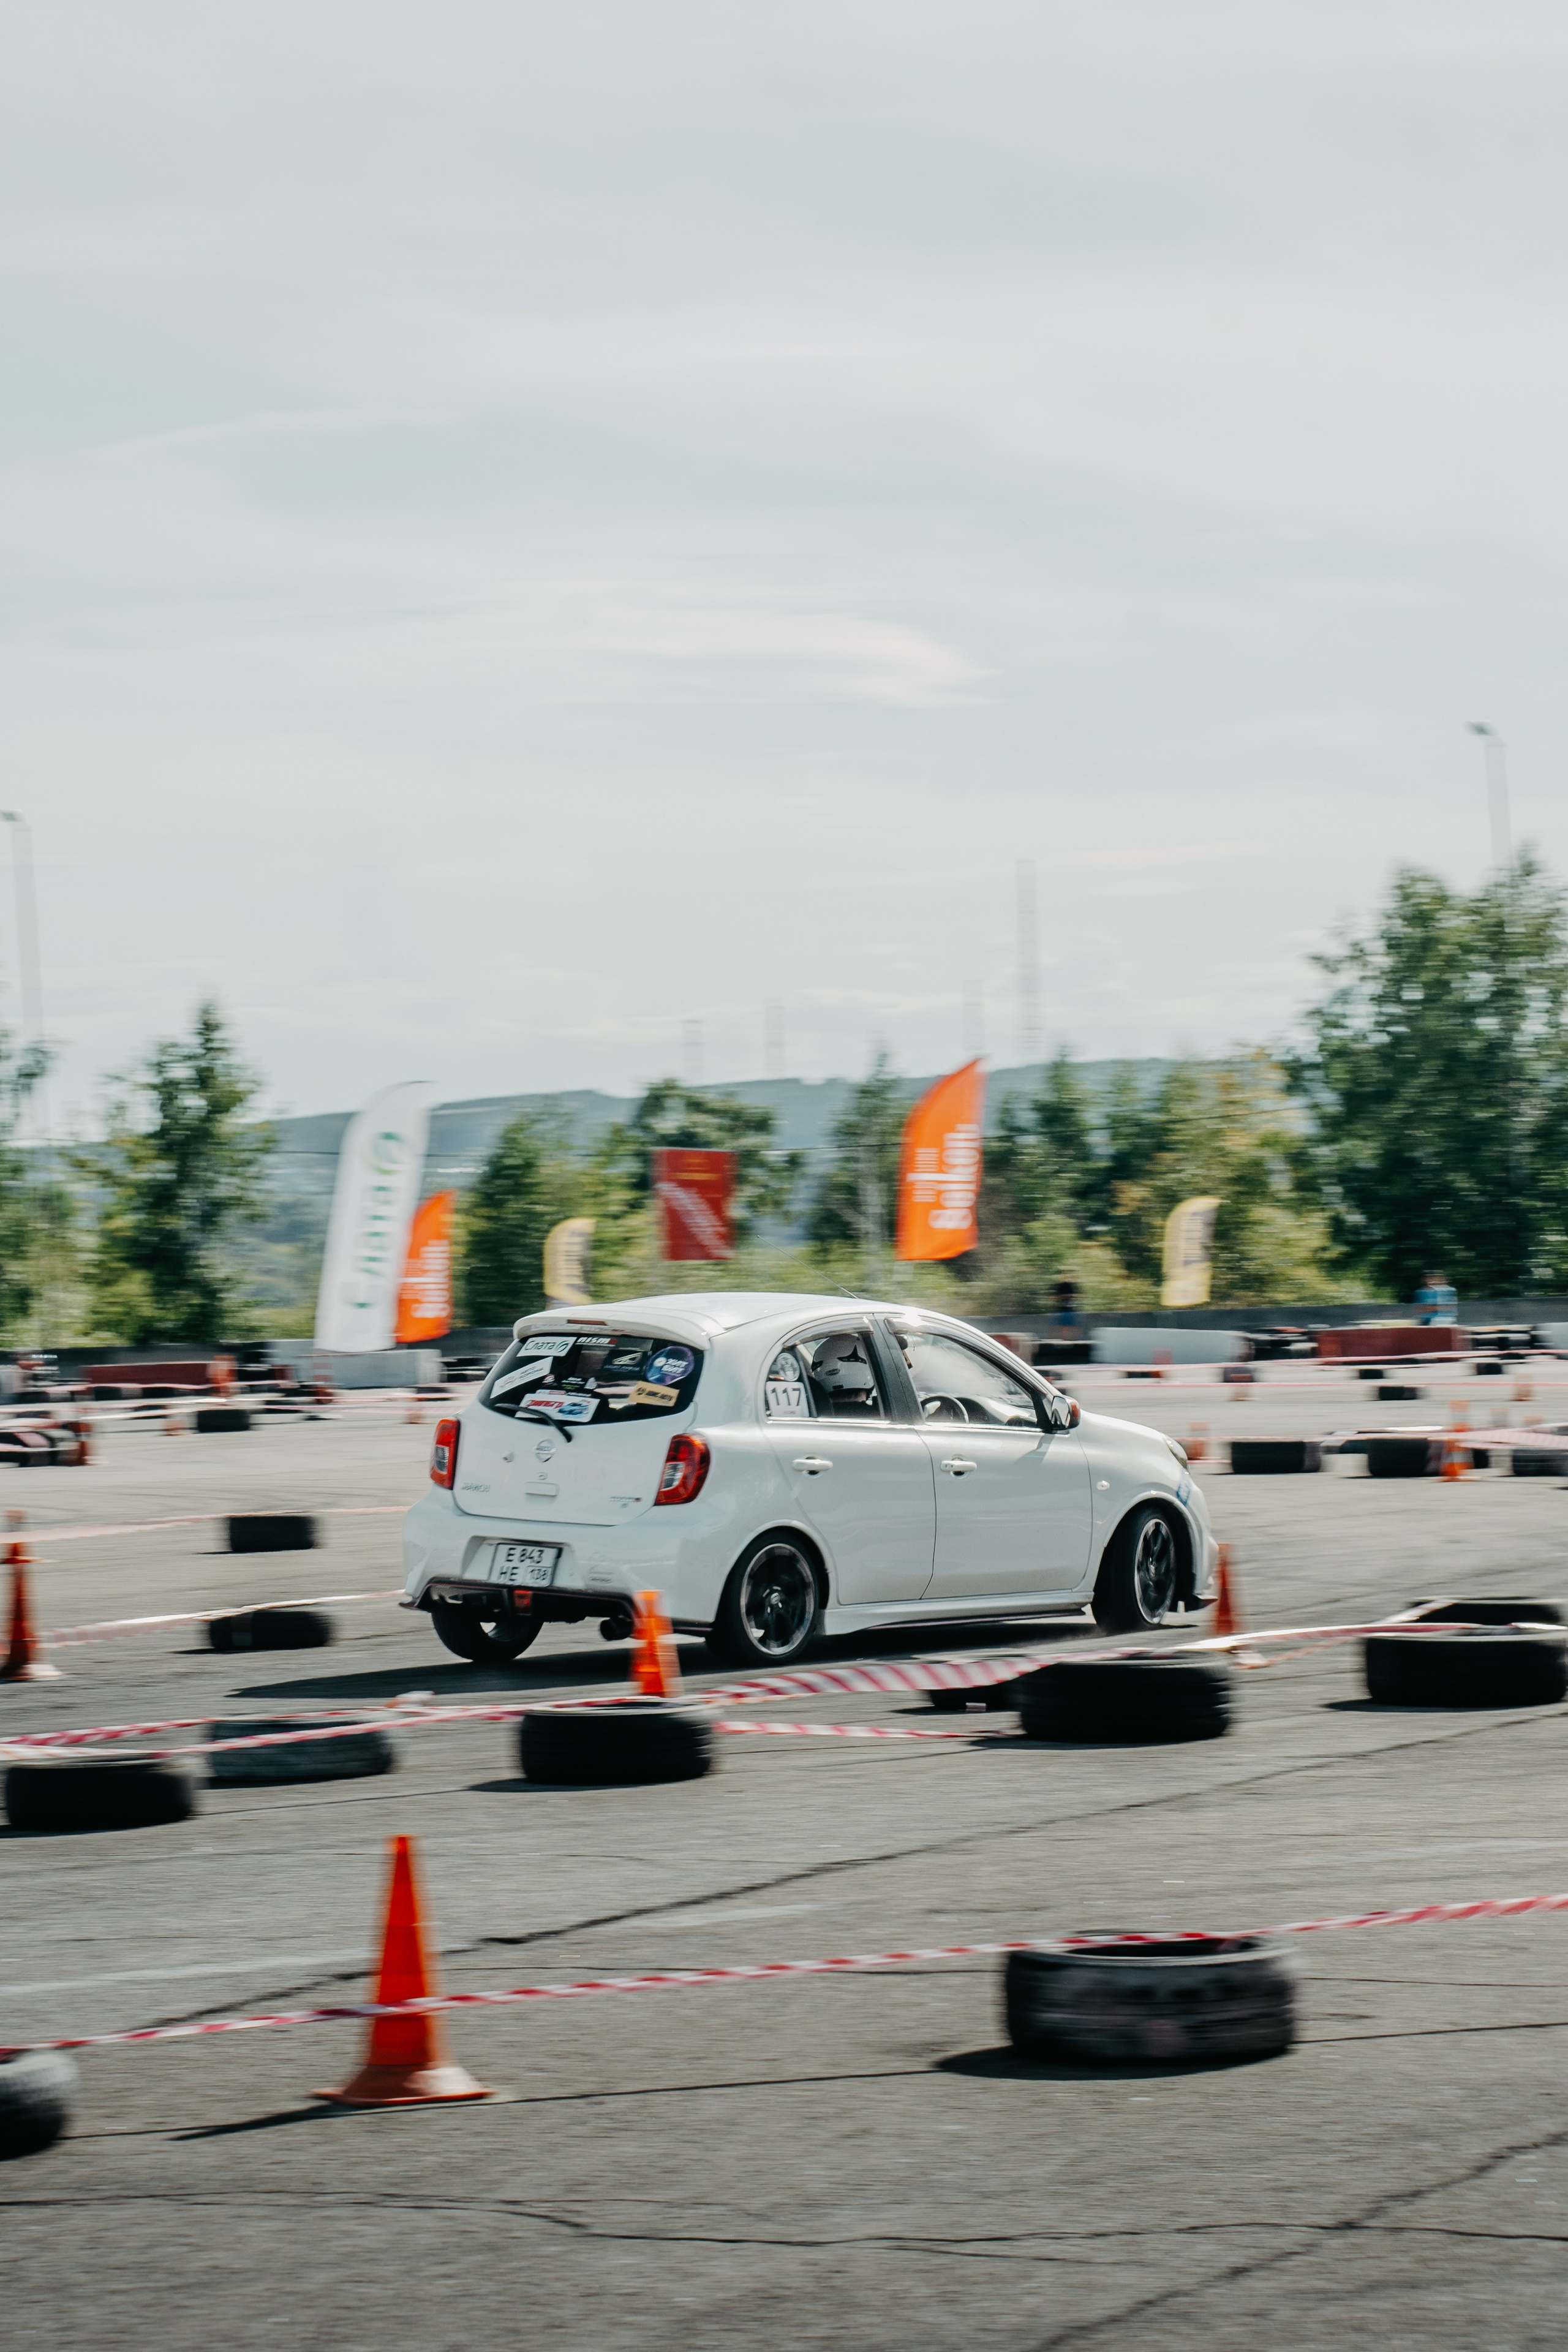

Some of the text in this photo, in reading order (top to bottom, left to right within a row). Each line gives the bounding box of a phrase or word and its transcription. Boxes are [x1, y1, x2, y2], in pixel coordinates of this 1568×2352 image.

[525, 1340, 555, 1351] Слата
[771, 1387, 801, 1406] 117
[529, 1569, 548, 1581] 138
